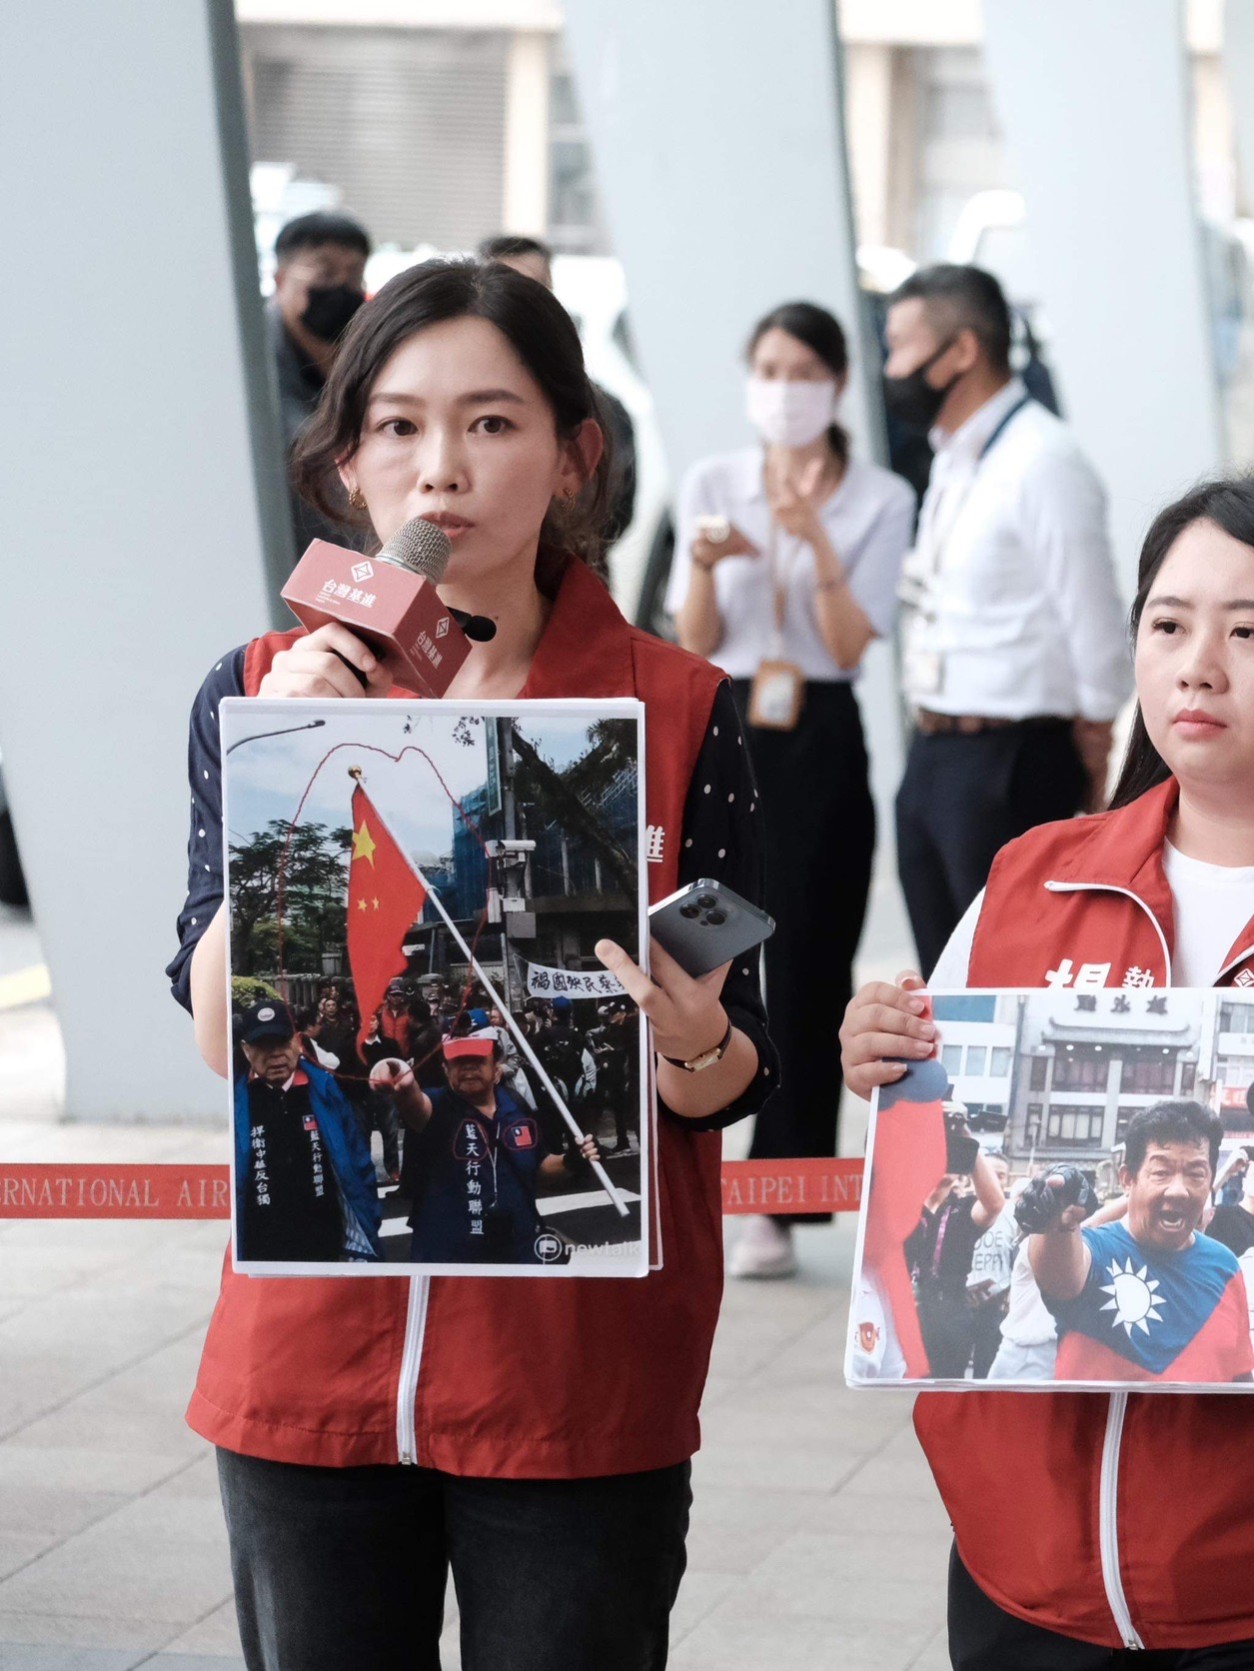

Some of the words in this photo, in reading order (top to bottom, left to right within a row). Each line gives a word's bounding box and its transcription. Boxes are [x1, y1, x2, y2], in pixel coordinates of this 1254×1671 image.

[322, 579, 377, 608] 台灣基進
[531, 970, 626, 994] 禍國殃民蔡
[0, 1177, 159, 1207] RNATIONAL
[465, 1123, 485, 1235] 藍天行動聯盟
